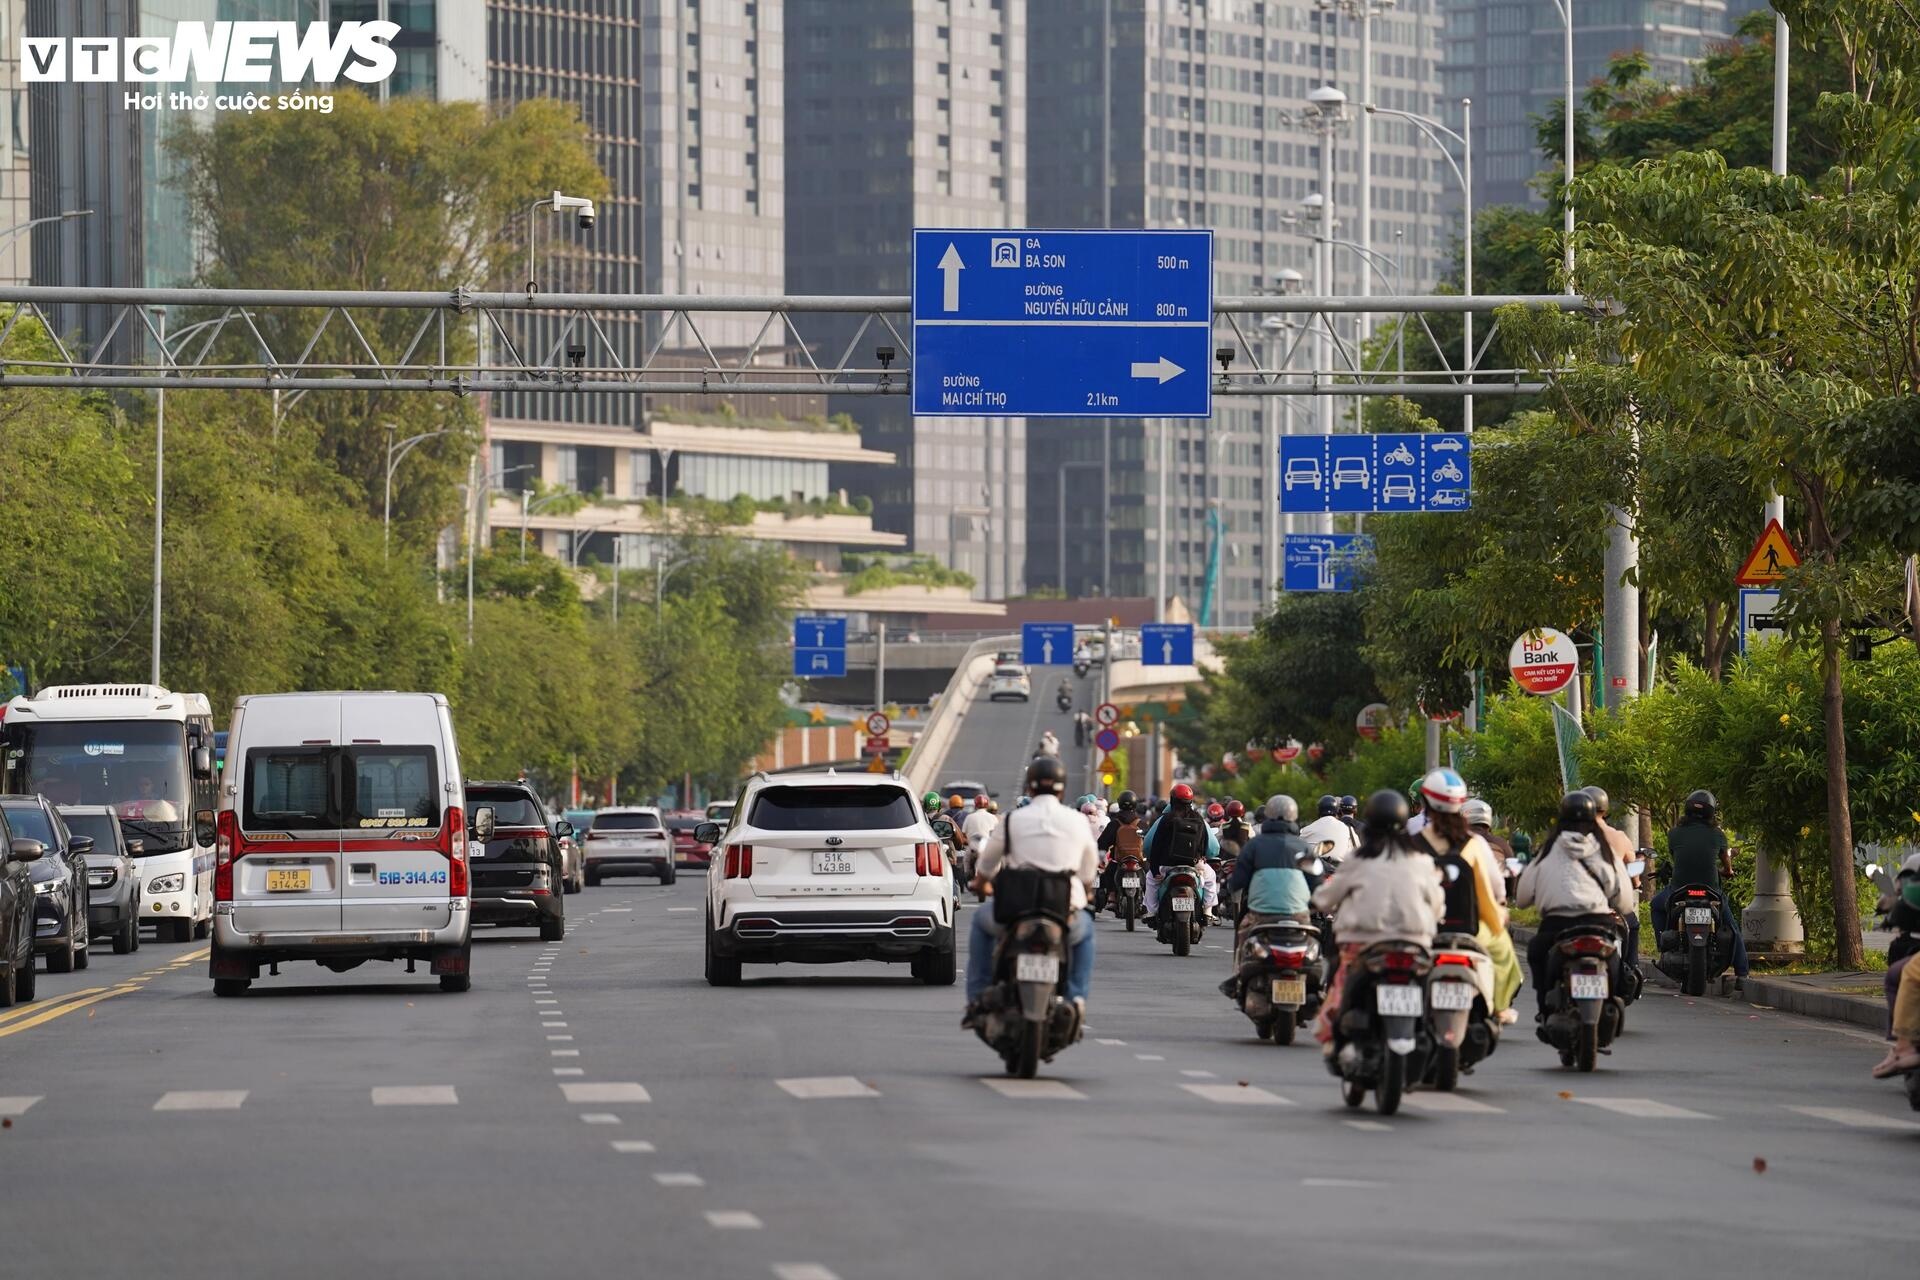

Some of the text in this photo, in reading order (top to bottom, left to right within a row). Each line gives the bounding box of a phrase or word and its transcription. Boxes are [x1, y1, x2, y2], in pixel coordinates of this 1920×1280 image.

[1026, 238, 1041, 249] GA
[1025, 255, 1189, 269] BA SON 500 m
[1024, 284, 1063, 296] ĐƯỜNG
[1025, 298, 1188, 317] NGUYỄN HỮU CẢNH 800 m
[943, 375, 980, 387] ĐƯỜNG
[943, 392, 963, 405] MAI
[965, 389, 983, 405] CHÍ
[985, 392, 1007, 409] THỌ
[1523, 640, 1543, 651] HD
[1524, 651, 1559, 664] Bank
[825, 853, 843, 862] 51K
[818, 863, 851, 872] 143.88
[279, 871, 299, 880] 51B
[379, 871, 447, 885] 51B-314.43
[272, 880, 306, 889] 314.43
